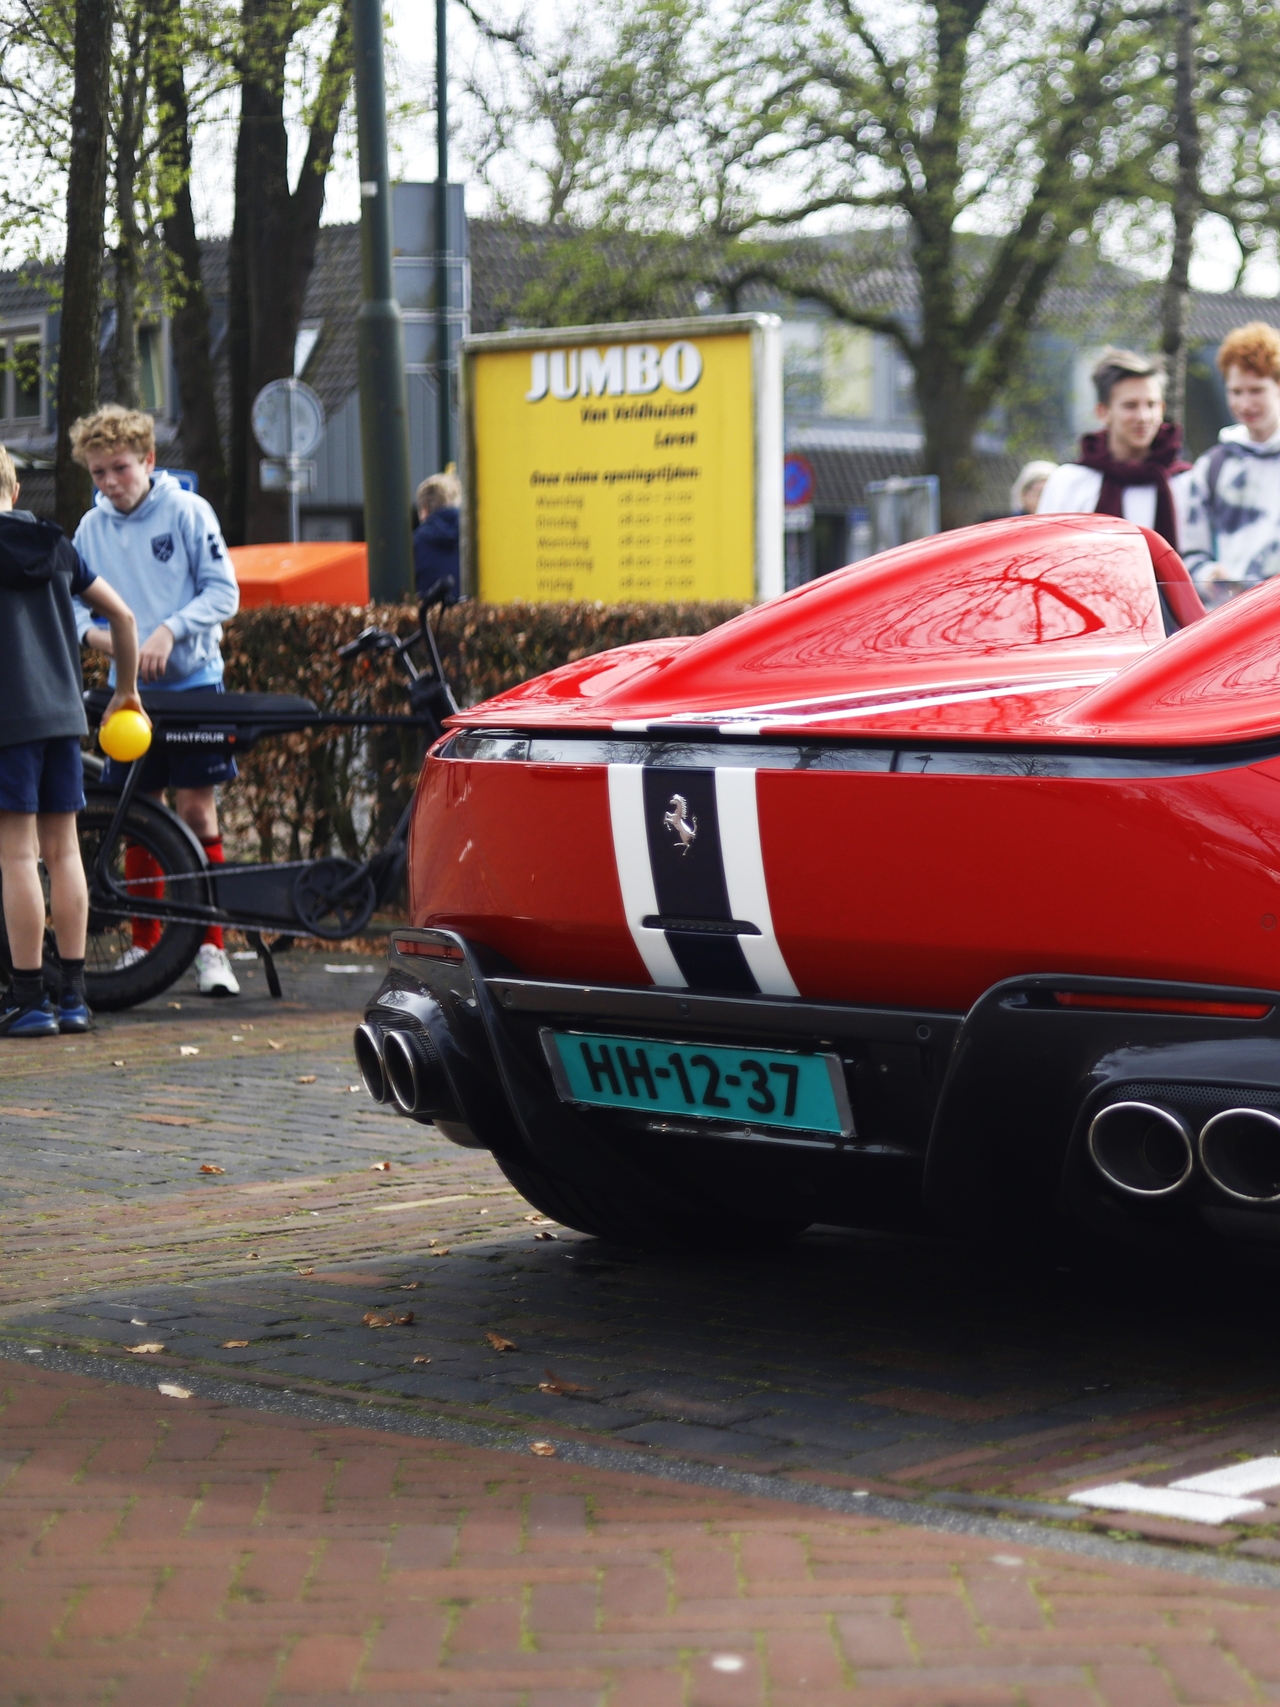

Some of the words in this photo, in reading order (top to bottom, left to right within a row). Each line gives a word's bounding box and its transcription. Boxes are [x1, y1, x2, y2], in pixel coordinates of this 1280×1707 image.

[525, 341, 703, 403] JUMBO
[581, 405, 607, 424] Van
[655, 430, 696, 448] Laren
[530, 470, 560, 487] Onze
[564, 466, 598, 485] ruime
[166, 732, 224, 744] PHATFOUR
[578, 1041, 800, 1117] HH-12-37
